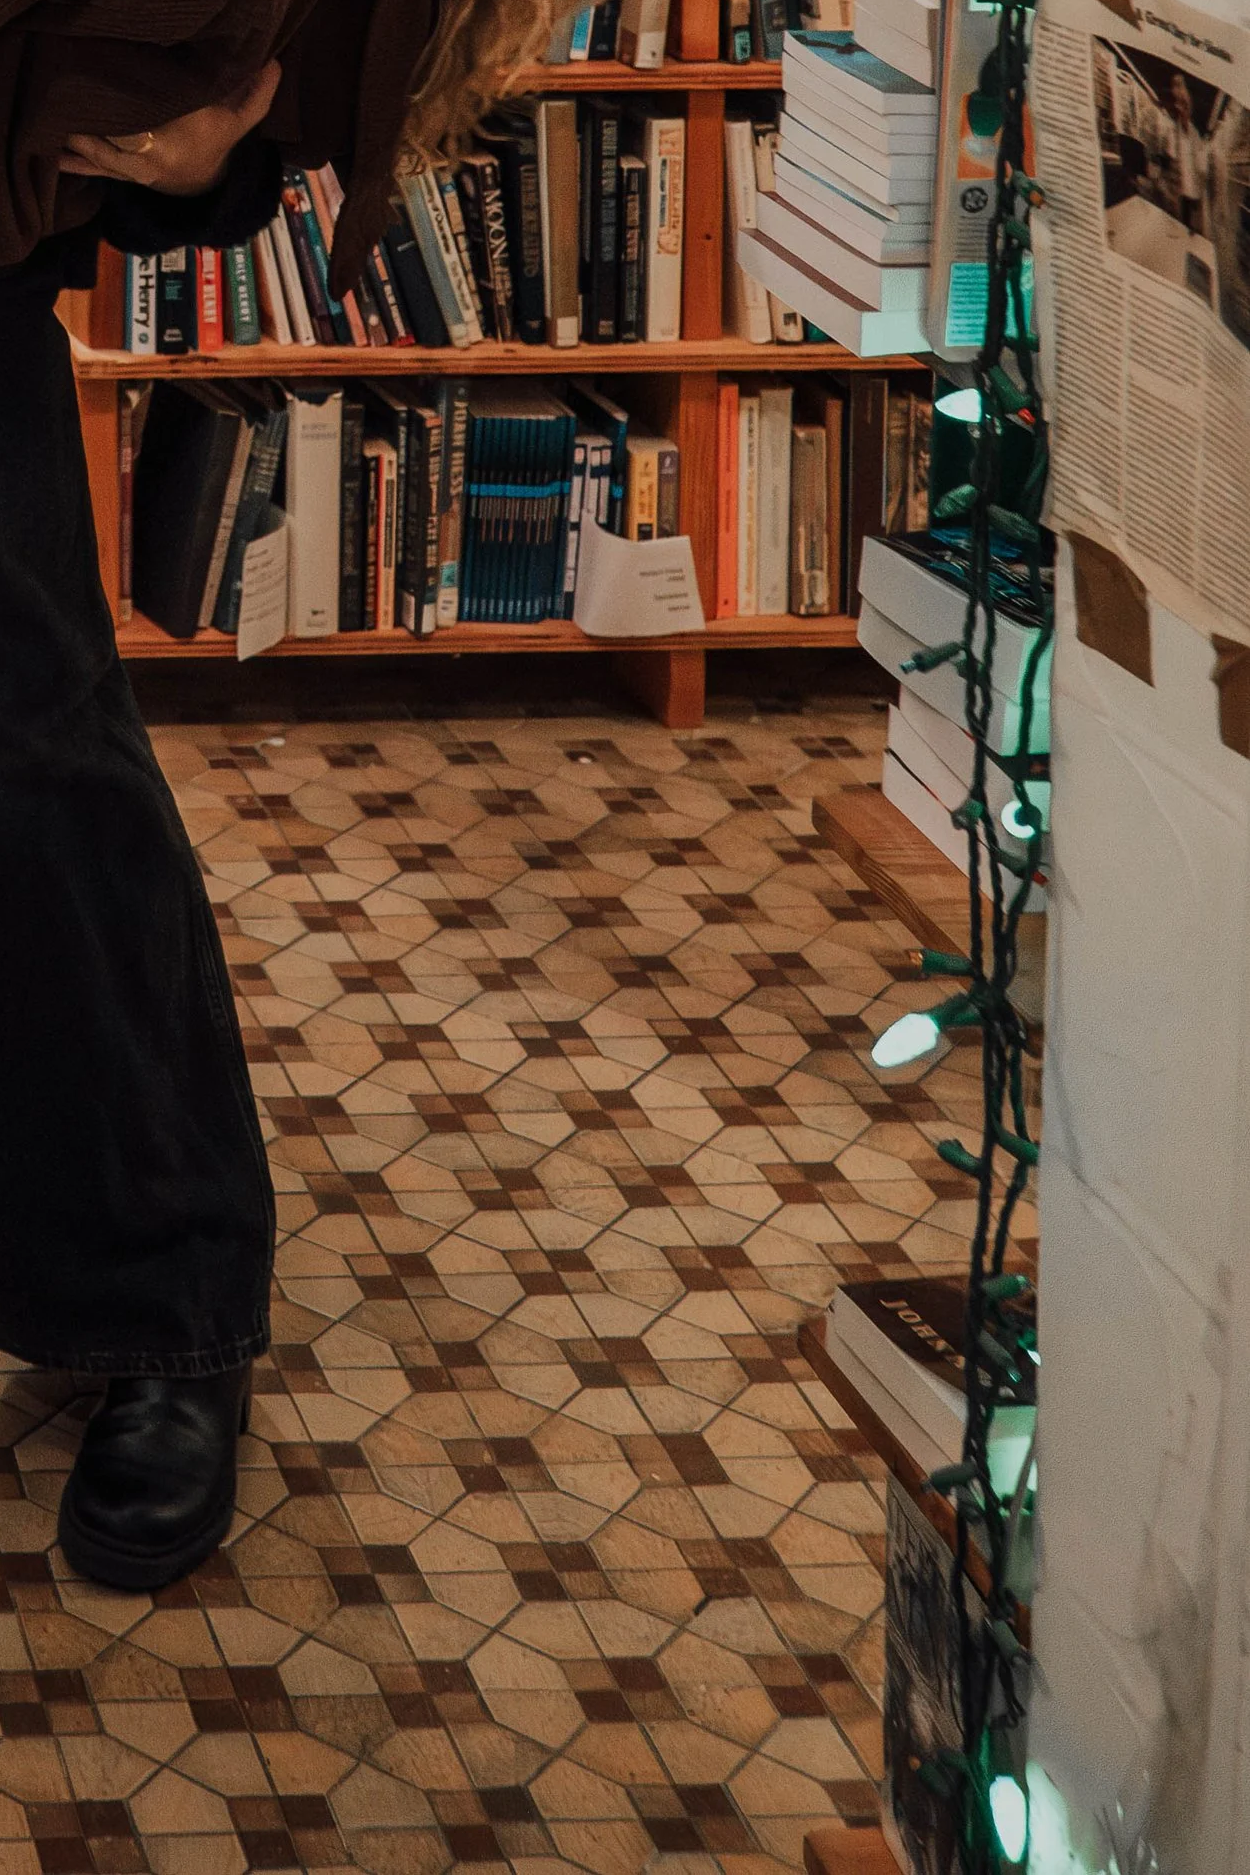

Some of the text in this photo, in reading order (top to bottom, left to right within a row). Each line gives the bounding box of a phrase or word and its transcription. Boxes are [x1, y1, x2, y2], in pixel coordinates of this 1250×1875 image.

[483, 188, 508, 259] MOON
[134, 274, 155, 329] Henry
[450, 401, 468, 497] JOAN HESS
